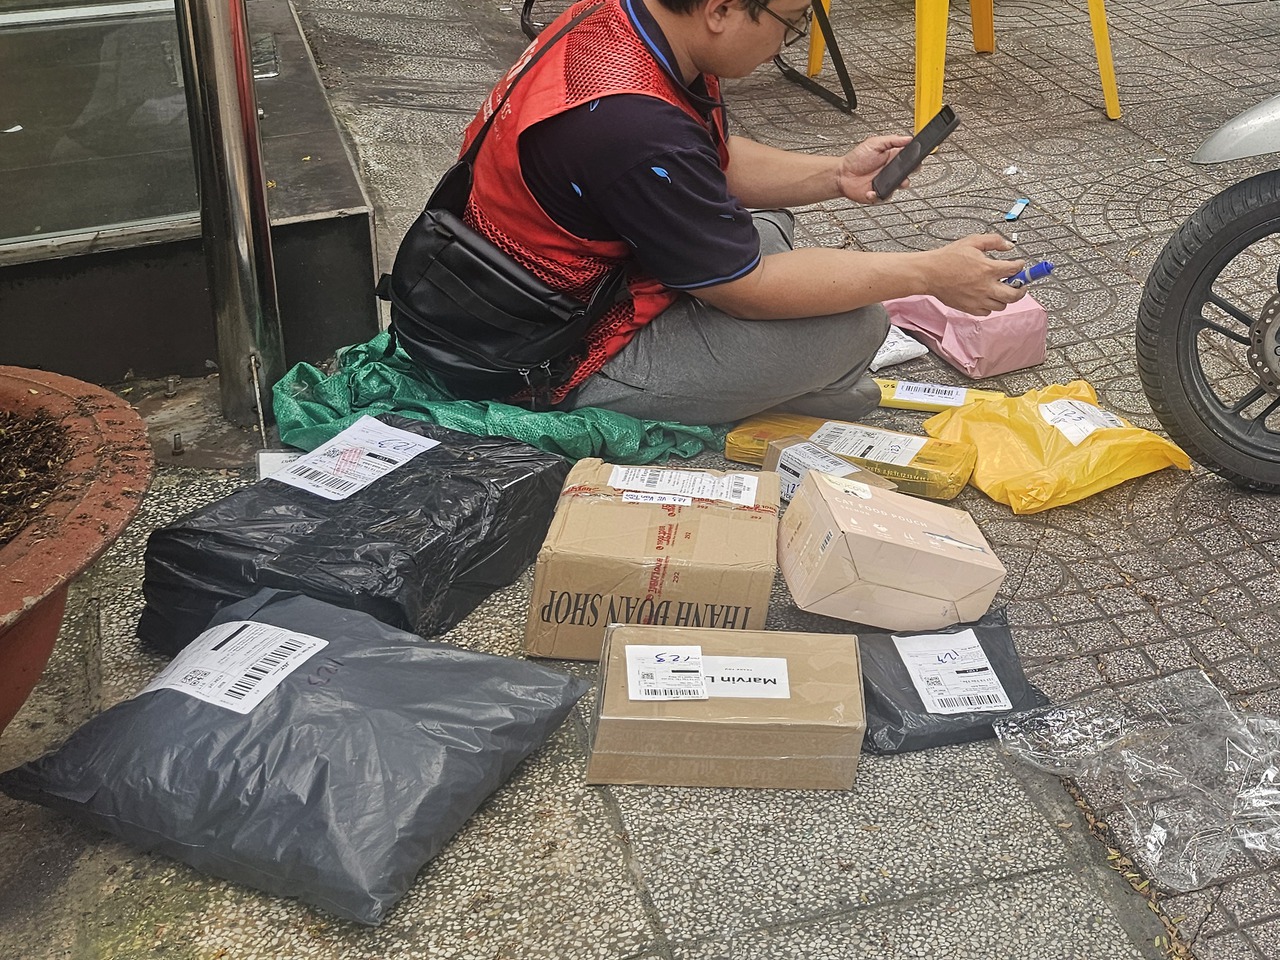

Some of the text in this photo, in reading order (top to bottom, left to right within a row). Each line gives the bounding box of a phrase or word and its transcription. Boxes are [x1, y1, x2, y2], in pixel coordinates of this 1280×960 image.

[786, 483, 801, 494] 12
[834, 496, 928, 528] CAT FOOD POUCH
[541, 590, 603, 628] SHOP
[654, 652, 691, 663] 123
[720, 675, 777, 685] Marvin
